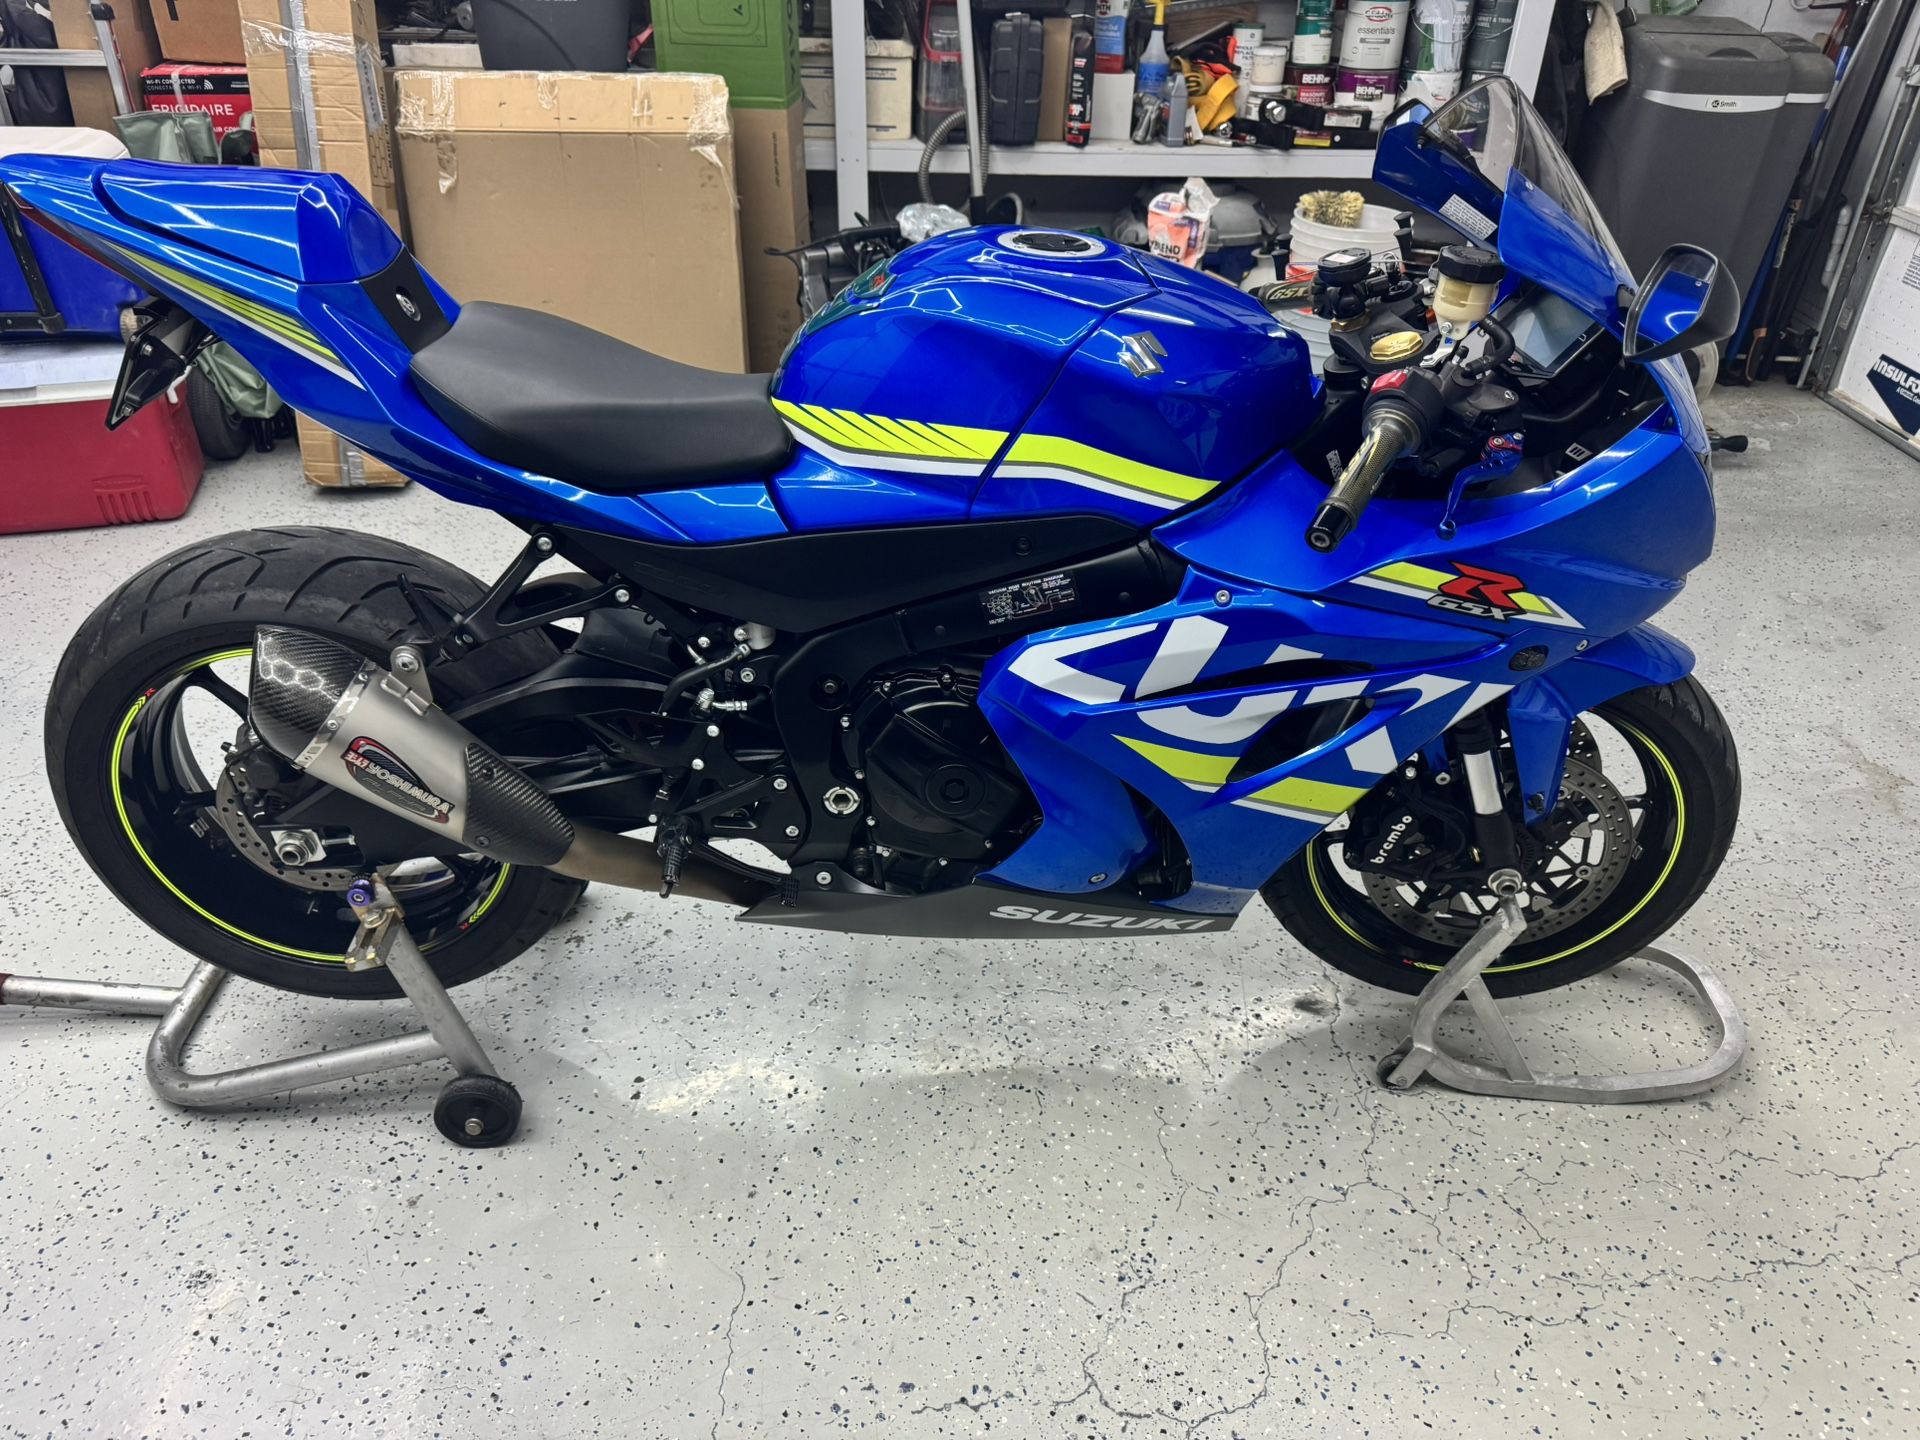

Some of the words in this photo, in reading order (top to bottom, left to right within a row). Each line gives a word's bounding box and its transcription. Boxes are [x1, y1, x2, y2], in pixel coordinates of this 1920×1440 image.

[1357, 27, 1396, 35] essentials
[1302, 73, 1325, 84] BEHR
[1355, 86, 1376, 95] BEHR
[151, 104, 235, 116] FRIGIDAIRE
[1438, 560, 1526, 611] R
[1426, 594, 1516, 622] GSX
[367, 762, 450, 814] YOSHIMURA
[1370, 815, 1413, 864] brembo
[990, 905, 1216, 930] SUZUKI
